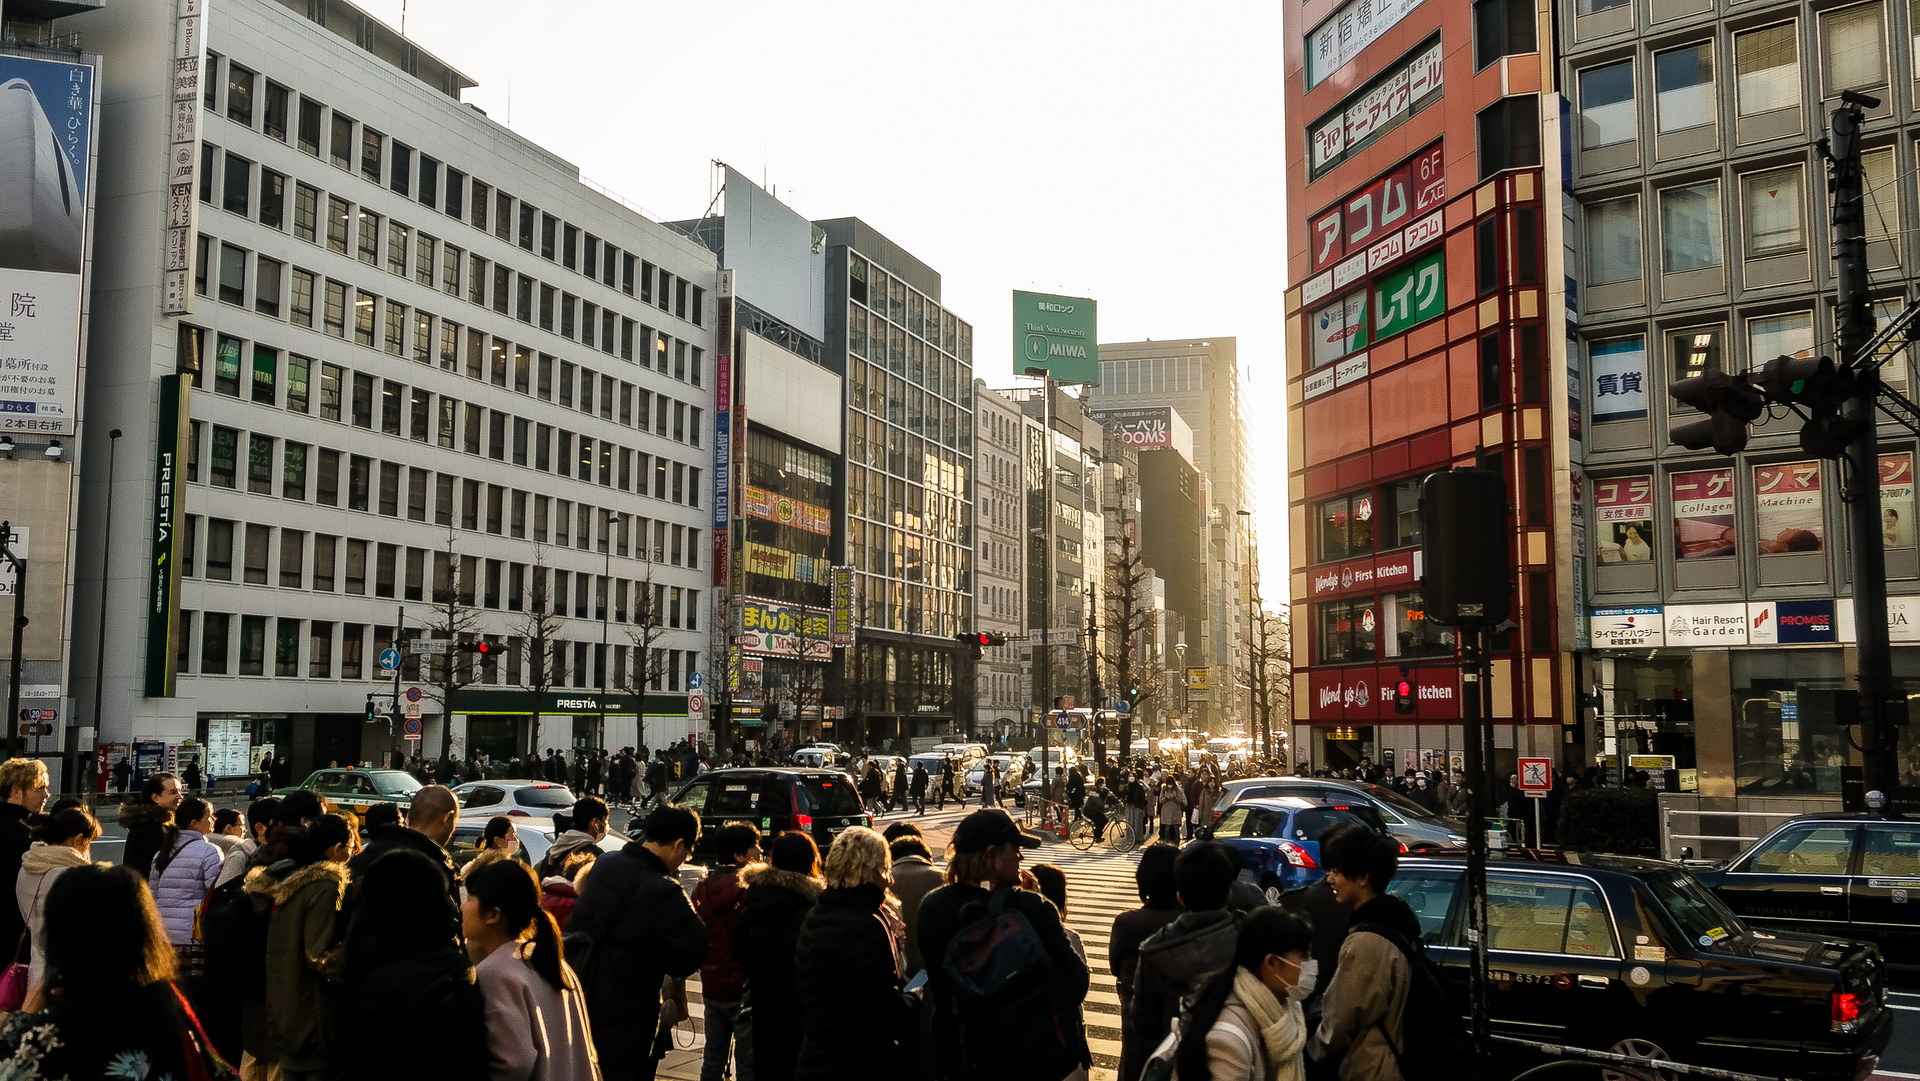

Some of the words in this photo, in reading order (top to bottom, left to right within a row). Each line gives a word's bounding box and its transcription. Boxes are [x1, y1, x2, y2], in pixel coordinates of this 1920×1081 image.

[185, 28, 193, 56] Bloom
[176, 58, 198, 72] 共立
[176, 75, 197, 89] 美容
[67, 68, 83, 165] 白き華、ひらく。
[1420, 150, 1441, 180] 6F
[171, 186, 191, 197] KEN
[1318, 179, 1408, 264] アコム
[1409, 219, 1439, 247] アコム
[1372, 240, 1399, 266] アコム
[1375, 263, 1439, 330] レイク
[10, 292, 37, 318] 院
[1038, 302, 1074, 313] 美和ロック
[1026, 322, 1045, 332] Think
[1046, 325, 1061, 333] Next
[1061, 327, 1086, 337] Security
[1050, 343, 1087, 359] MIWA
[1596, 371, 1643, 397] 賃貸
[5, 419, 63, 431] 2本目右折
[1122, 430, 1167, 444] OOMS
[717, 431, 728, 463] JAPAN
[716, 465, 727, 496] TOTAL
[1598, 481, 1650, 504] コラ
[1675, 472, 1731, 496] ーゲ
[1760, 468, 1818, 492] ンマ
[1883, 461, 1909, 482] ン
[1681, 503, 1733, 513] Collagen
[1760, 497, 1814, 507] Machine
[715, 496, 727, 523] CLUB
[1604, 508, 1645, 519] 女性専用
[1316, 574, 1339, 593] Wendy's
[1355, 570, 1373, 581] First
[1377, 564, 1408, 578] Kitchen
[1407, 610, 1424, 621] Firs
[1692, 616, 1711, 625] Hair
[1713, 616, 1744, 625] Resort
[1781, 615, 1830, 625] PROMISE
[1595, 629, 1660, 638] タイセイ・ハウジー
[1692, 626, 1745, 636] Garden
[1320, 683, 1354, 708] Wendy's
[1381, 687, 1395, 700] Fir
[1418, 686, 1452, 699] itchen
[31, 710, 40, 718] 20
[1057, 717, 1070, 726] 414
[1516, 974, 1551, 985] 6572
